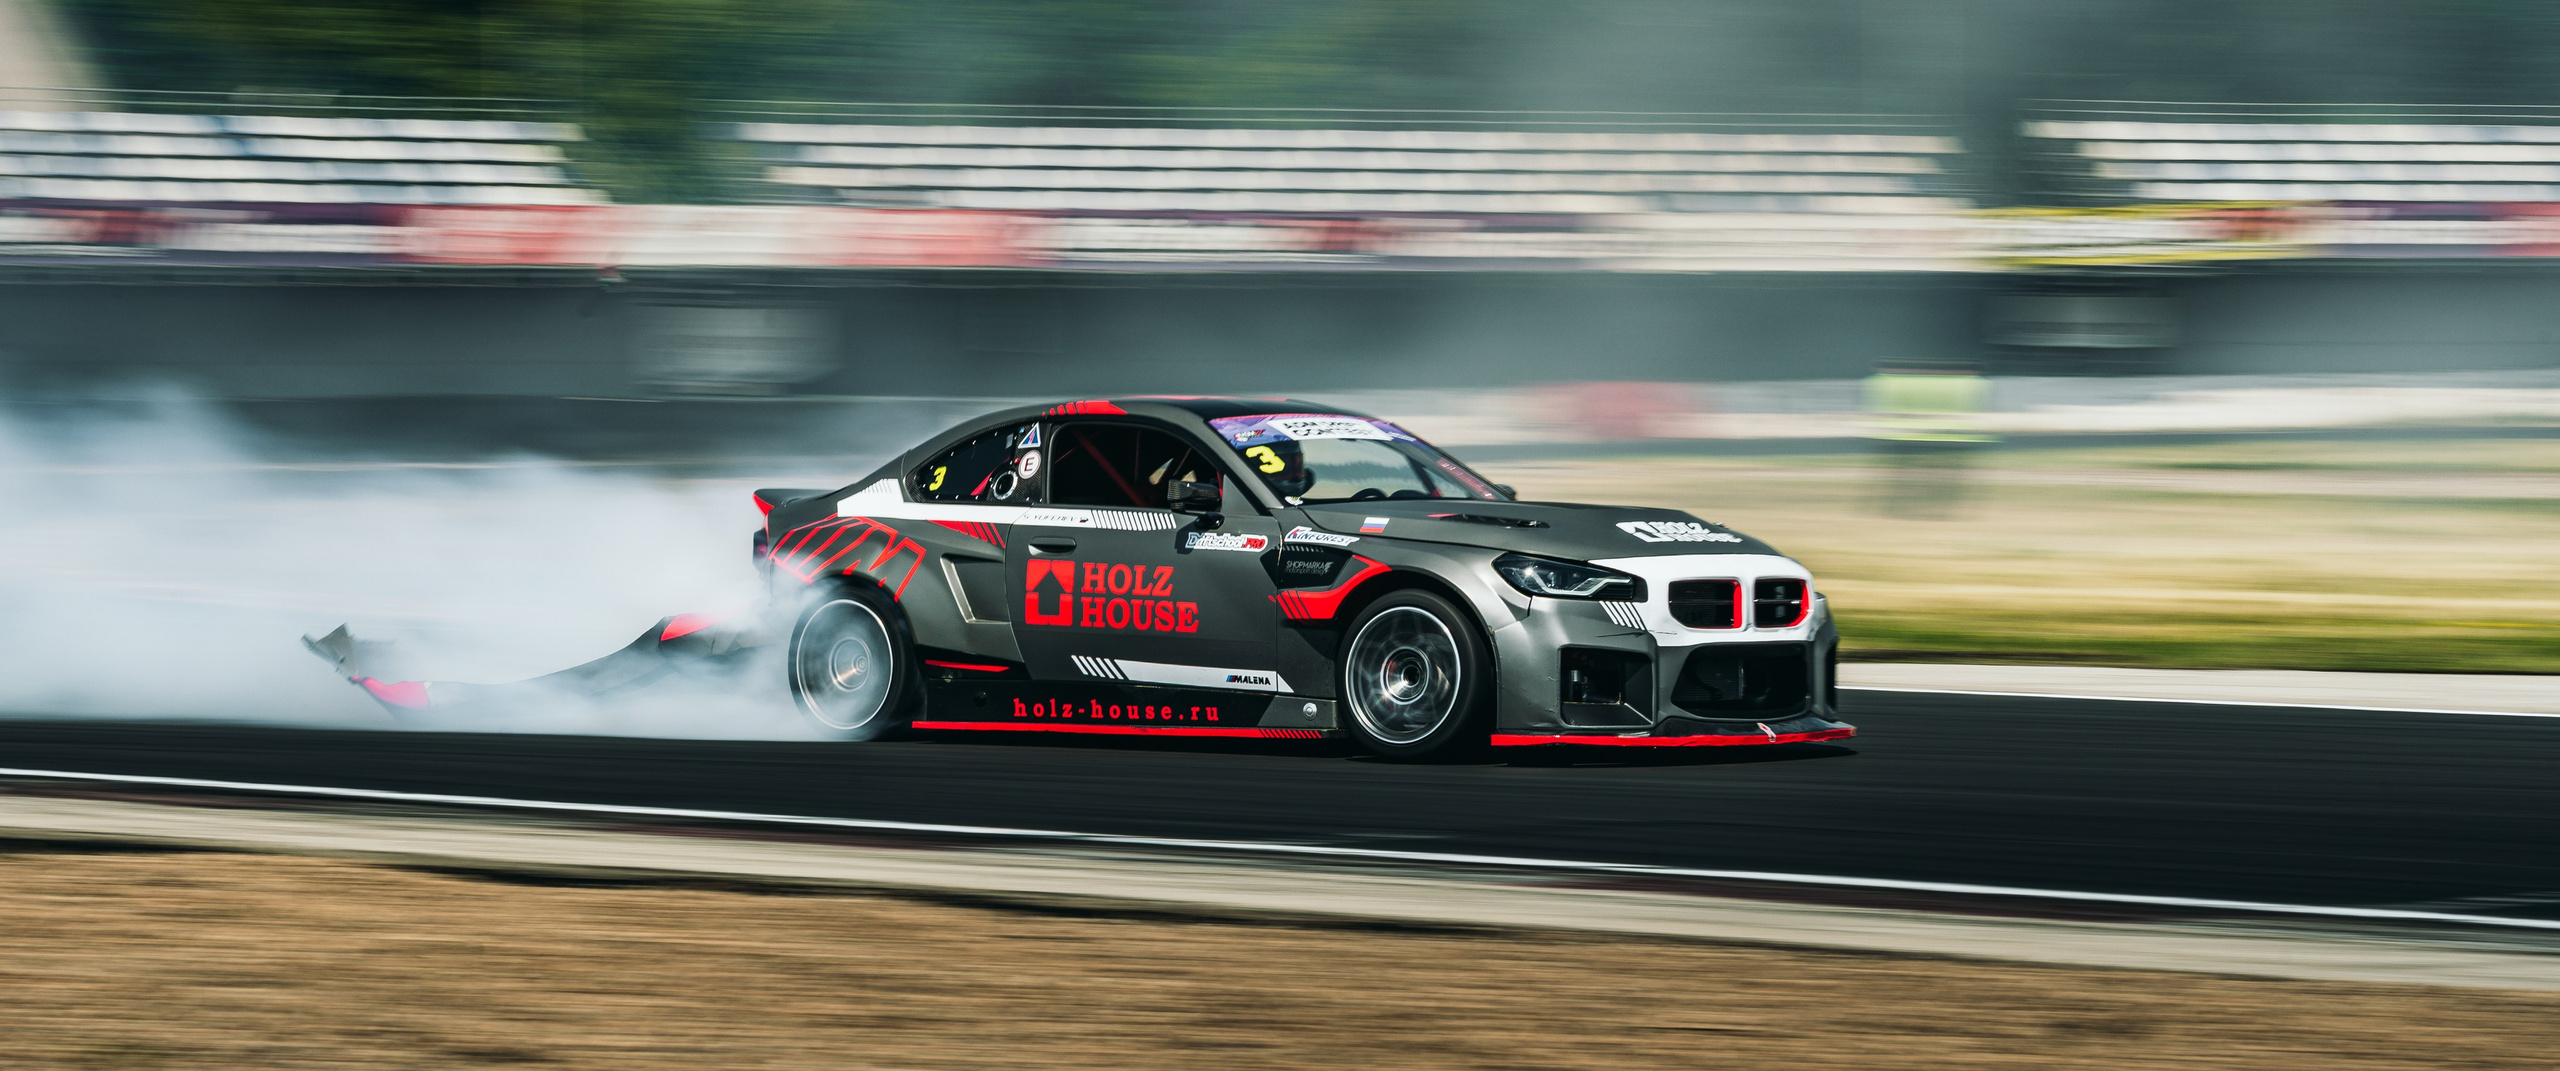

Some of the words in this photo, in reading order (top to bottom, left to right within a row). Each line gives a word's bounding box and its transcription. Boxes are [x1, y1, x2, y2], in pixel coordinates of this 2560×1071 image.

[1024, 456, 1035, 472] E
[1245, 445, 1286, 475] 3
[928, 465, 948, 492] 3
[1286, 560, 1325, 569] SHOPMARKA
[1081, 562, 1174, 597] HOLZ
[1080, 596, 1199, 633] HOUSE
[1013, 698, 1219, 721] holz-house.ru
